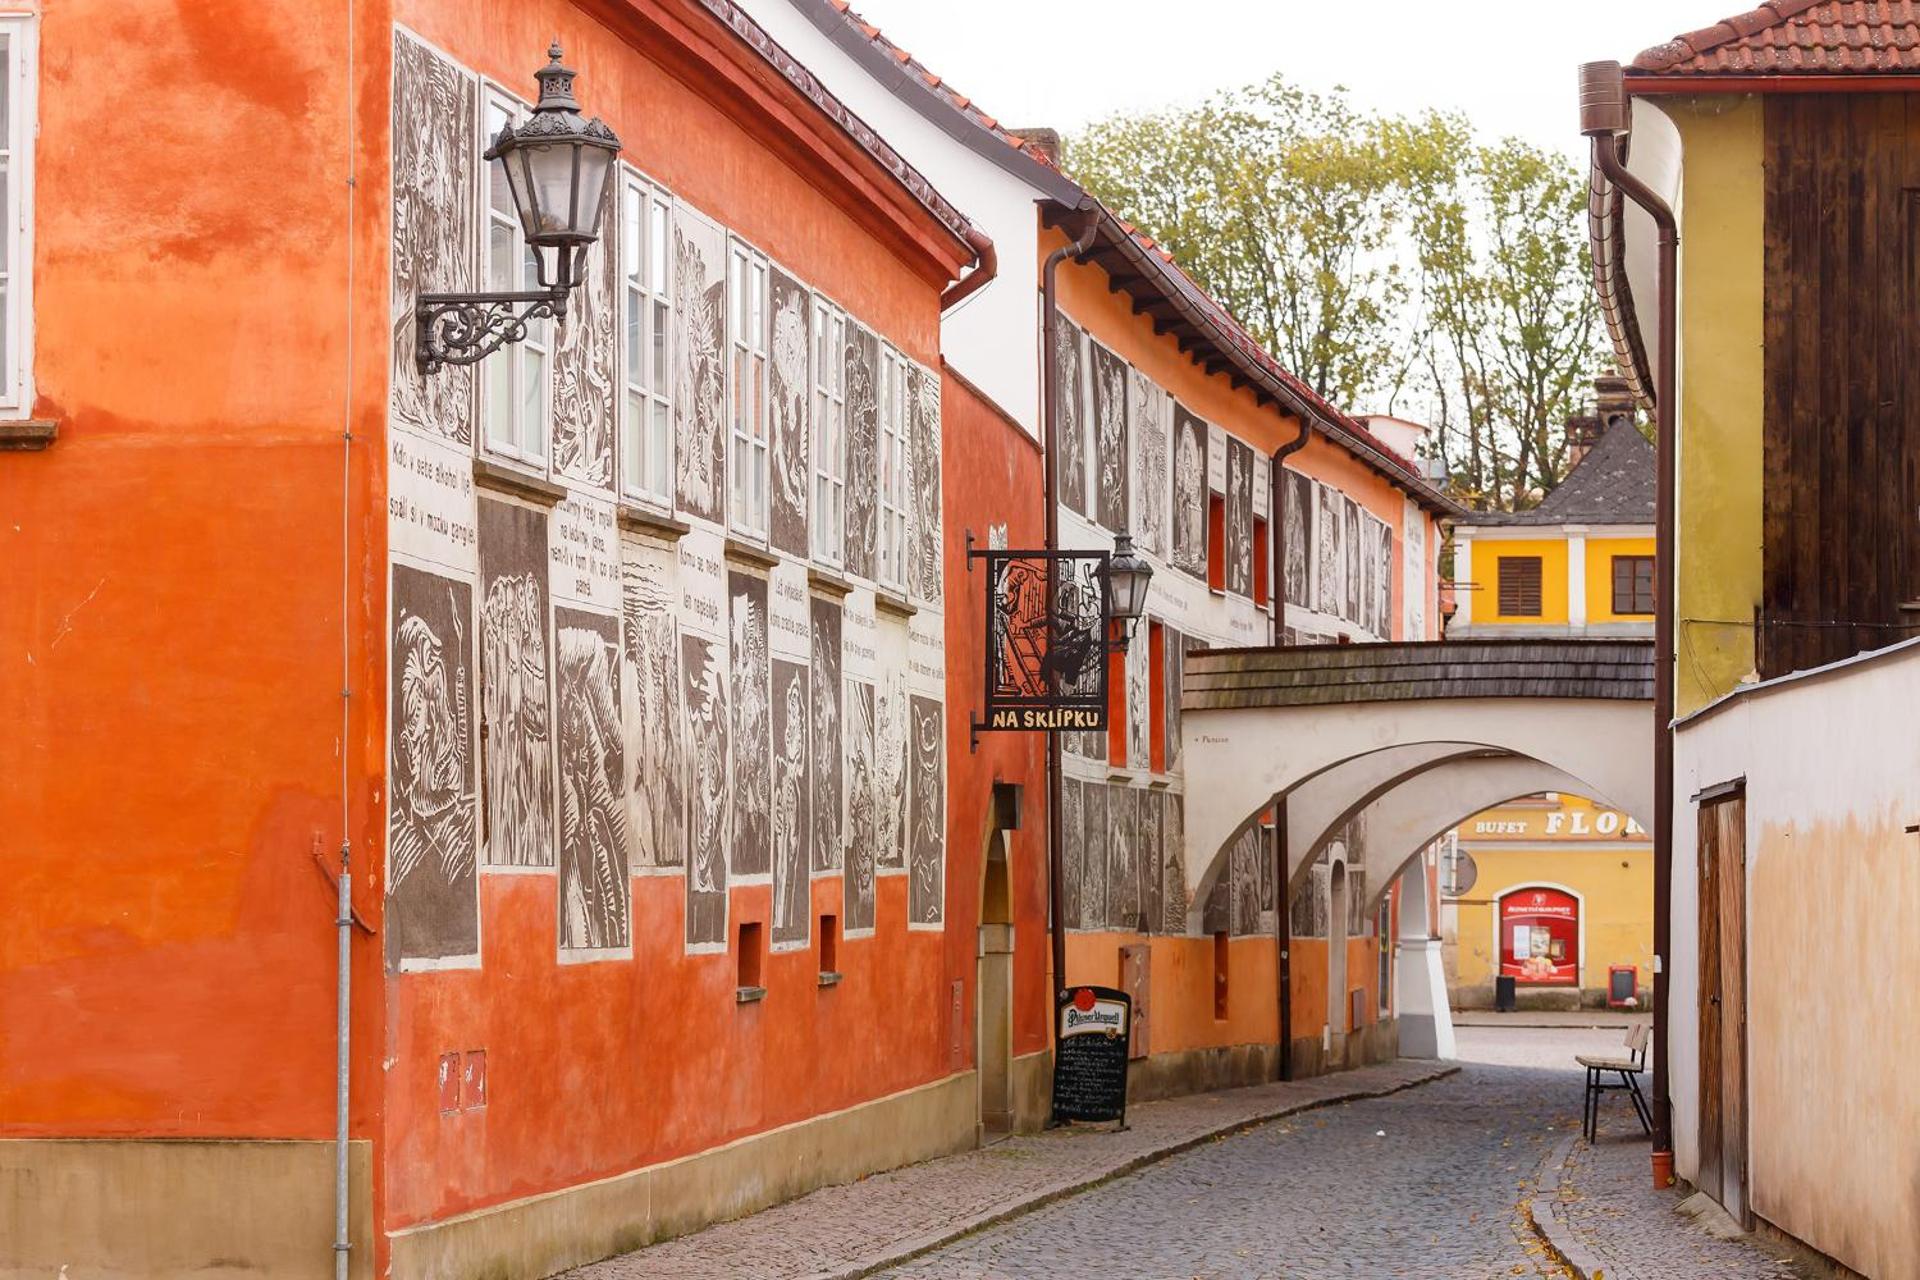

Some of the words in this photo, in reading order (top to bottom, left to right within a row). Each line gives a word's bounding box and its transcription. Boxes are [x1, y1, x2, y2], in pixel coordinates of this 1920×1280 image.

[392, 440, 407, 468] Kdo
[993, 711, 1018, 728] NA
[1023, 709, 1099, 728] SKLÍPKU
[1476, 821, 1527, 834] BUFET
[1068, 1008, 1093, 1028] Pilsner
[1093, 1010, 1120, 1025] Urquell
